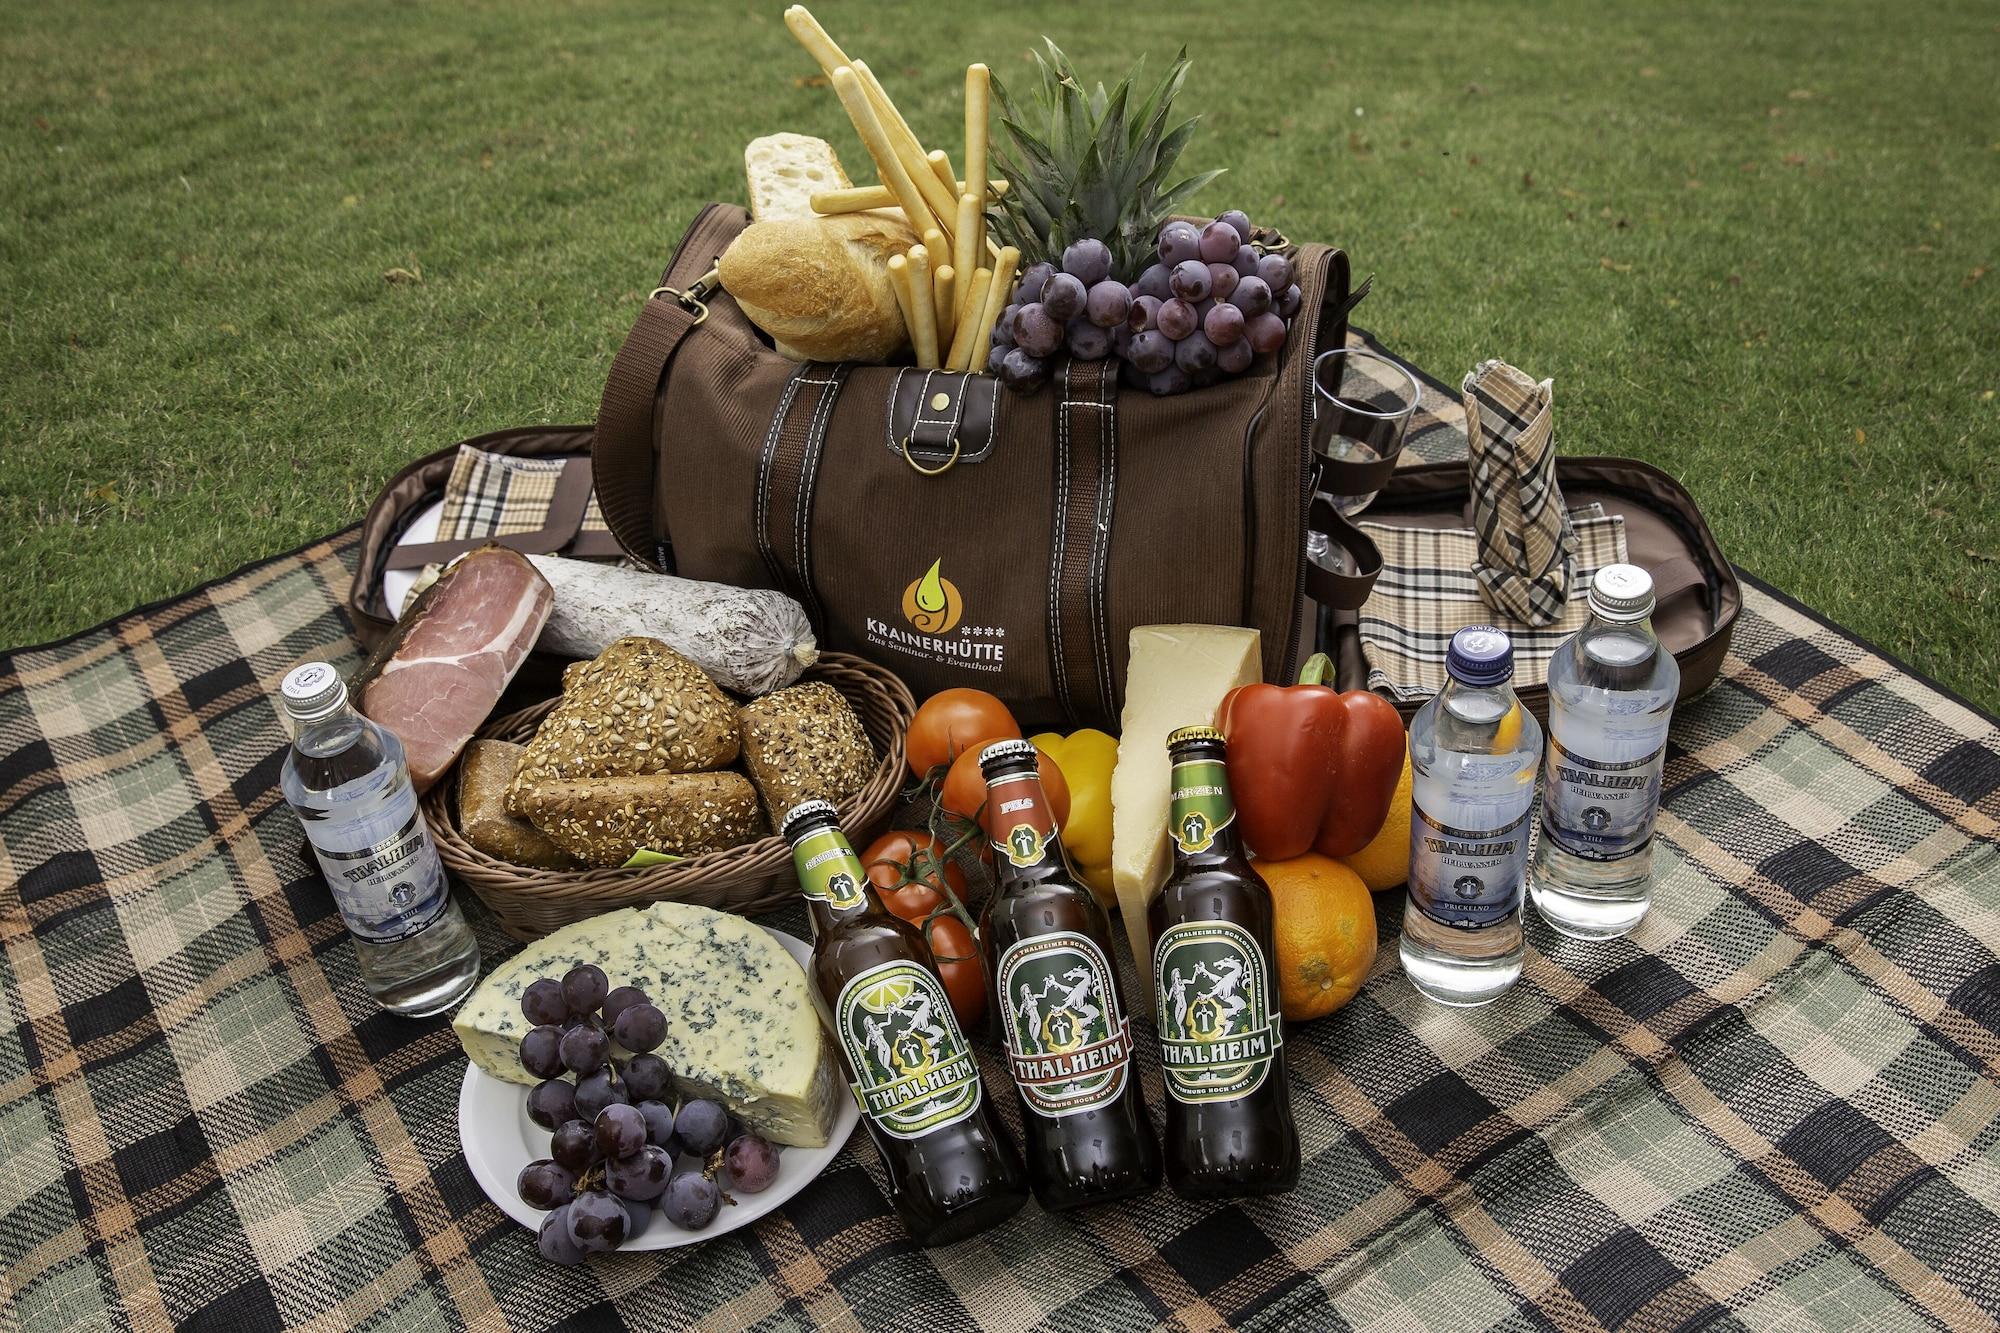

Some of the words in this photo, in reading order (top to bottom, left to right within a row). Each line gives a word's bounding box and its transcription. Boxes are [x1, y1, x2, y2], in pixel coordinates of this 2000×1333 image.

[867, 617, 1003, 661] KRAINERHÜTTE
[867, 633, 886, 646] Das
[887, 641, 934, 659] Seminar-
[936, 655, 945, 663] &
[946, 657, 1003, 672] Eventhotel
[1556, 765, 1648, 790] THALHEIM
[1423, 836, 1518, 857] THALHEIM
[1583, 835, 1603, 843] STILL
[342, 832, 425, 883] THALHEIM
[401, 908, 418, 921] STILL
[1443, 903, 1490, 912] PRICKELND
[1174, 929, 1223, 940] THALHEIMER
[1019, 940, 1068, 956] THALHEIMER
[1016, 1041, 1122, 1079] THALHEIM
[1162, 1036, 1266, 1064] THALHEIM
[869, 1058, 974, 1110] THALHEIM
[1174, 1083, 1207, 1094] STIMMUNG
[1232, 1079, 1250, 1091] ZWEI
[1035, 1098, 1072, 1109] STIMMUNG
[1074, 1096, 1095, 1106] HOCH
[1096, 1086, 1113, 1099] ZWEI
